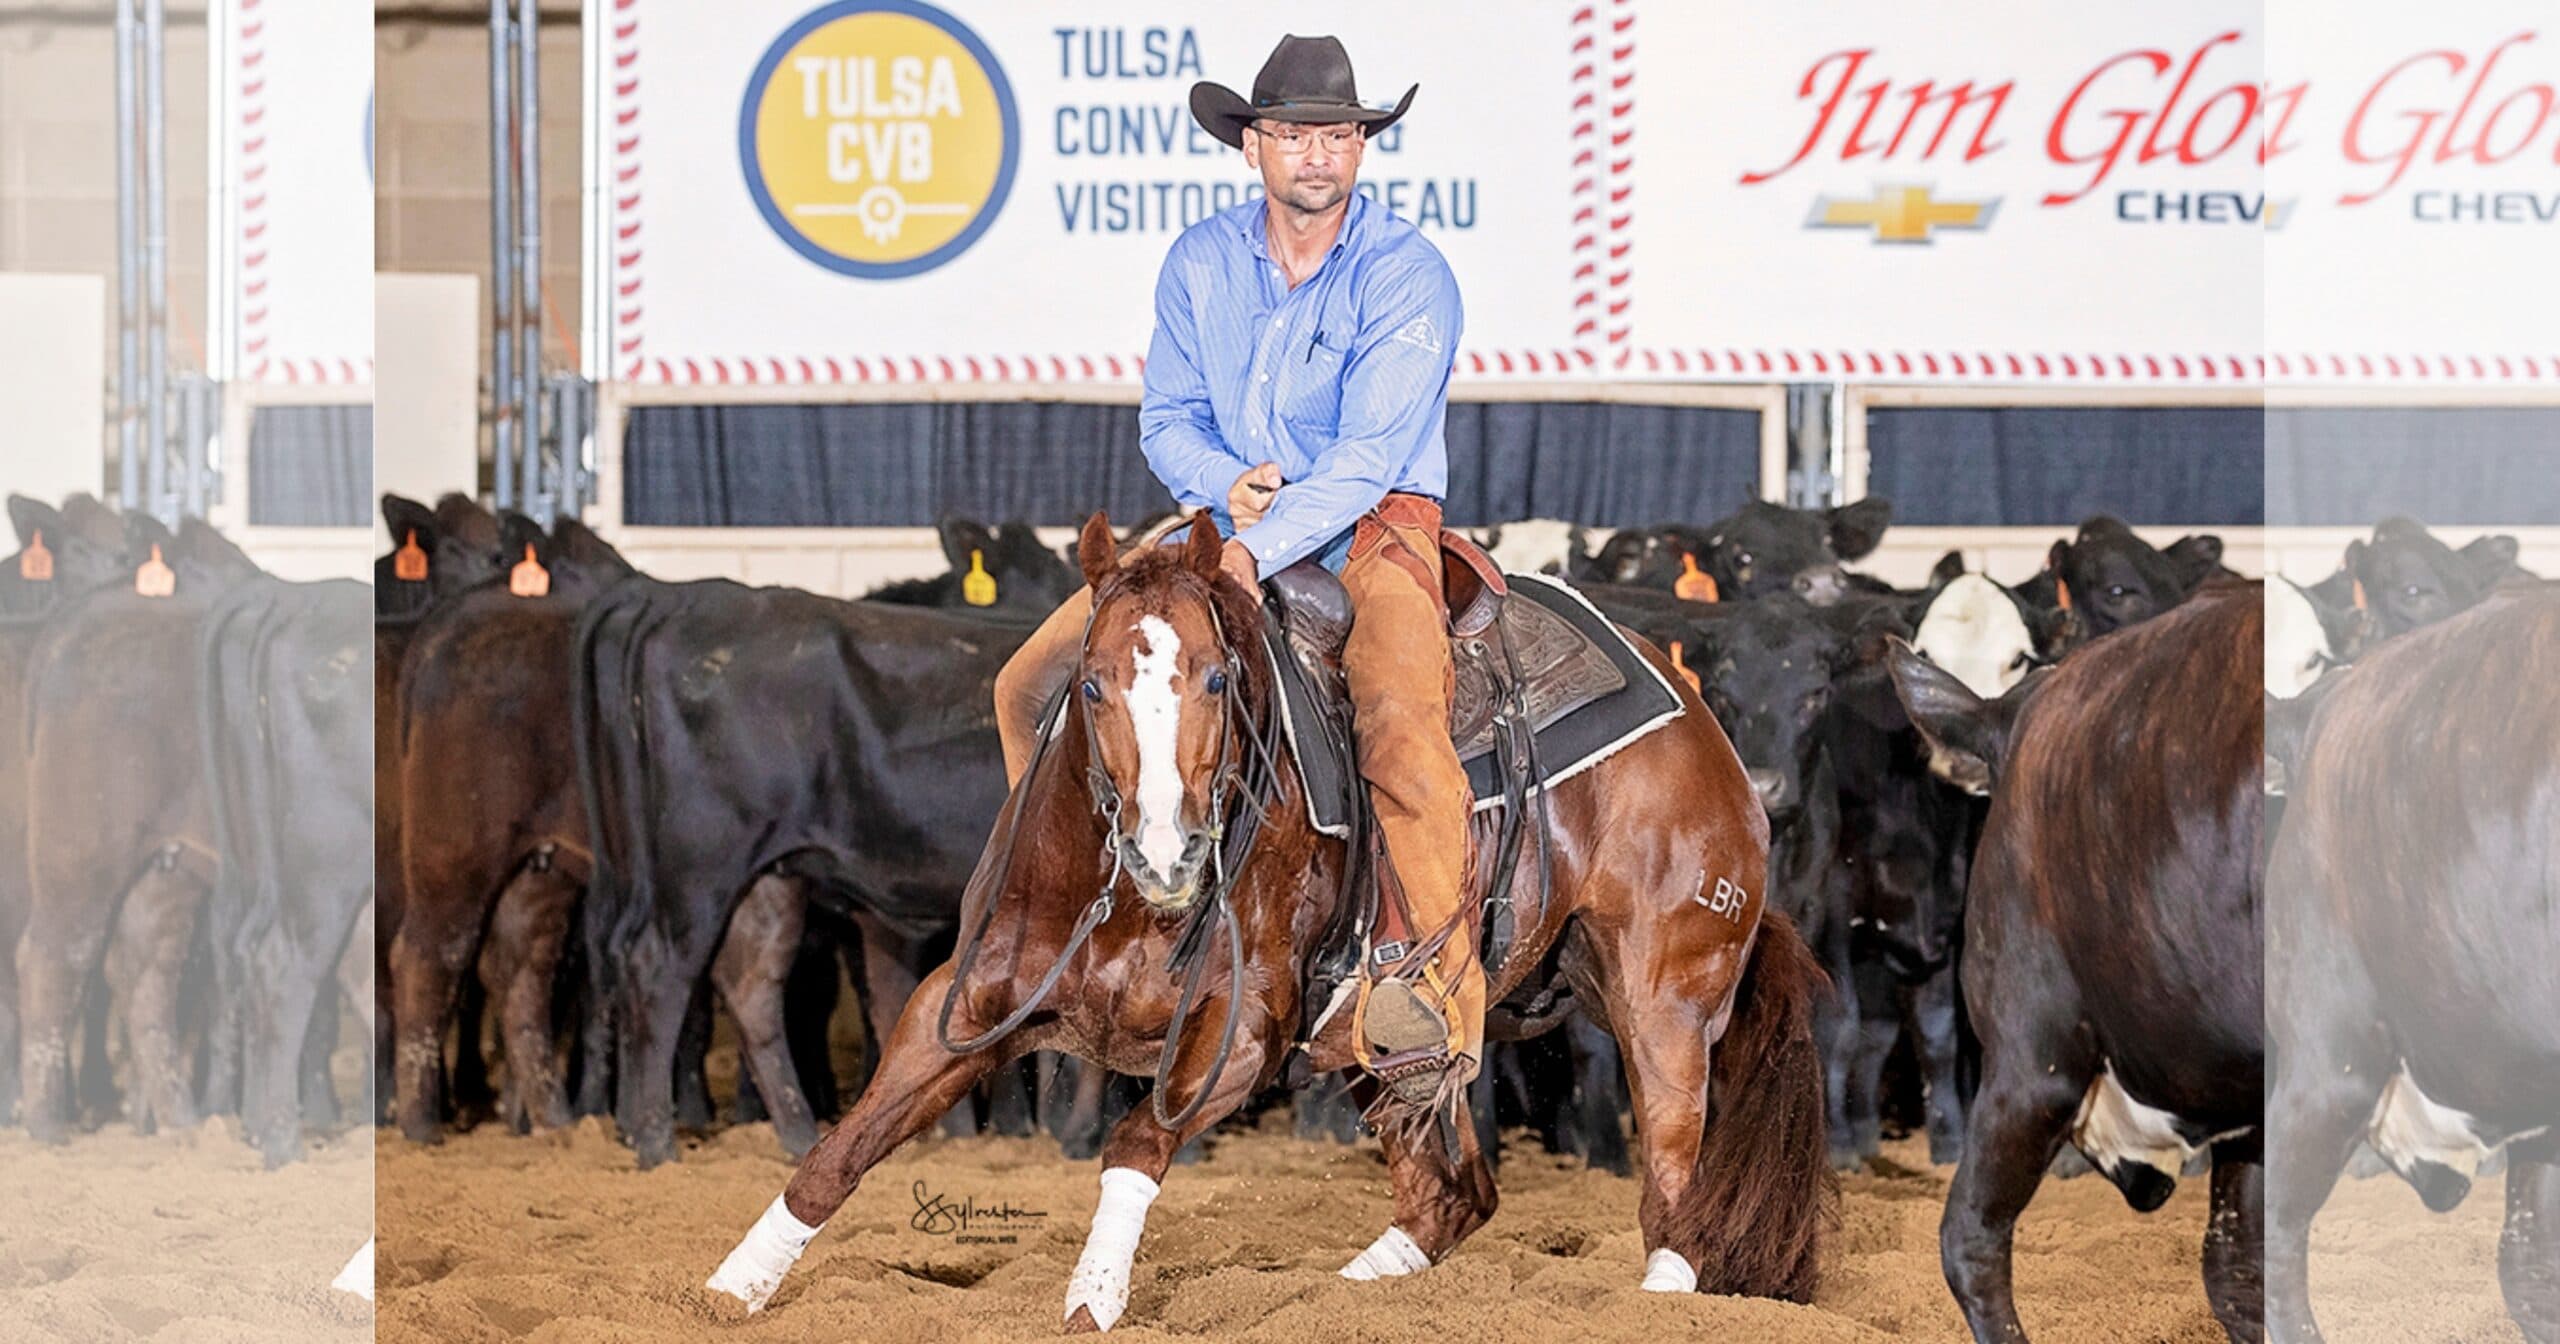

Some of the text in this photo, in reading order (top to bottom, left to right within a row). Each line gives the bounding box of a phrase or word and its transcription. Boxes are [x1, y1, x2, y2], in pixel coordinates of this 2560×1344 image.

[1054, 28, 1204, 78] TULSA
[795, 55, 963, 118] TULSA
[1055, 104, 1226, 156] CONVE
[1738, 48, 2014, 182] Jim
[2041, 30, 2264, 207] Glo
[2337, 32, 2560, 206] Glo
[828, 121, 933, 183] CVB
[1695, 868, 1748, 924] LBR
